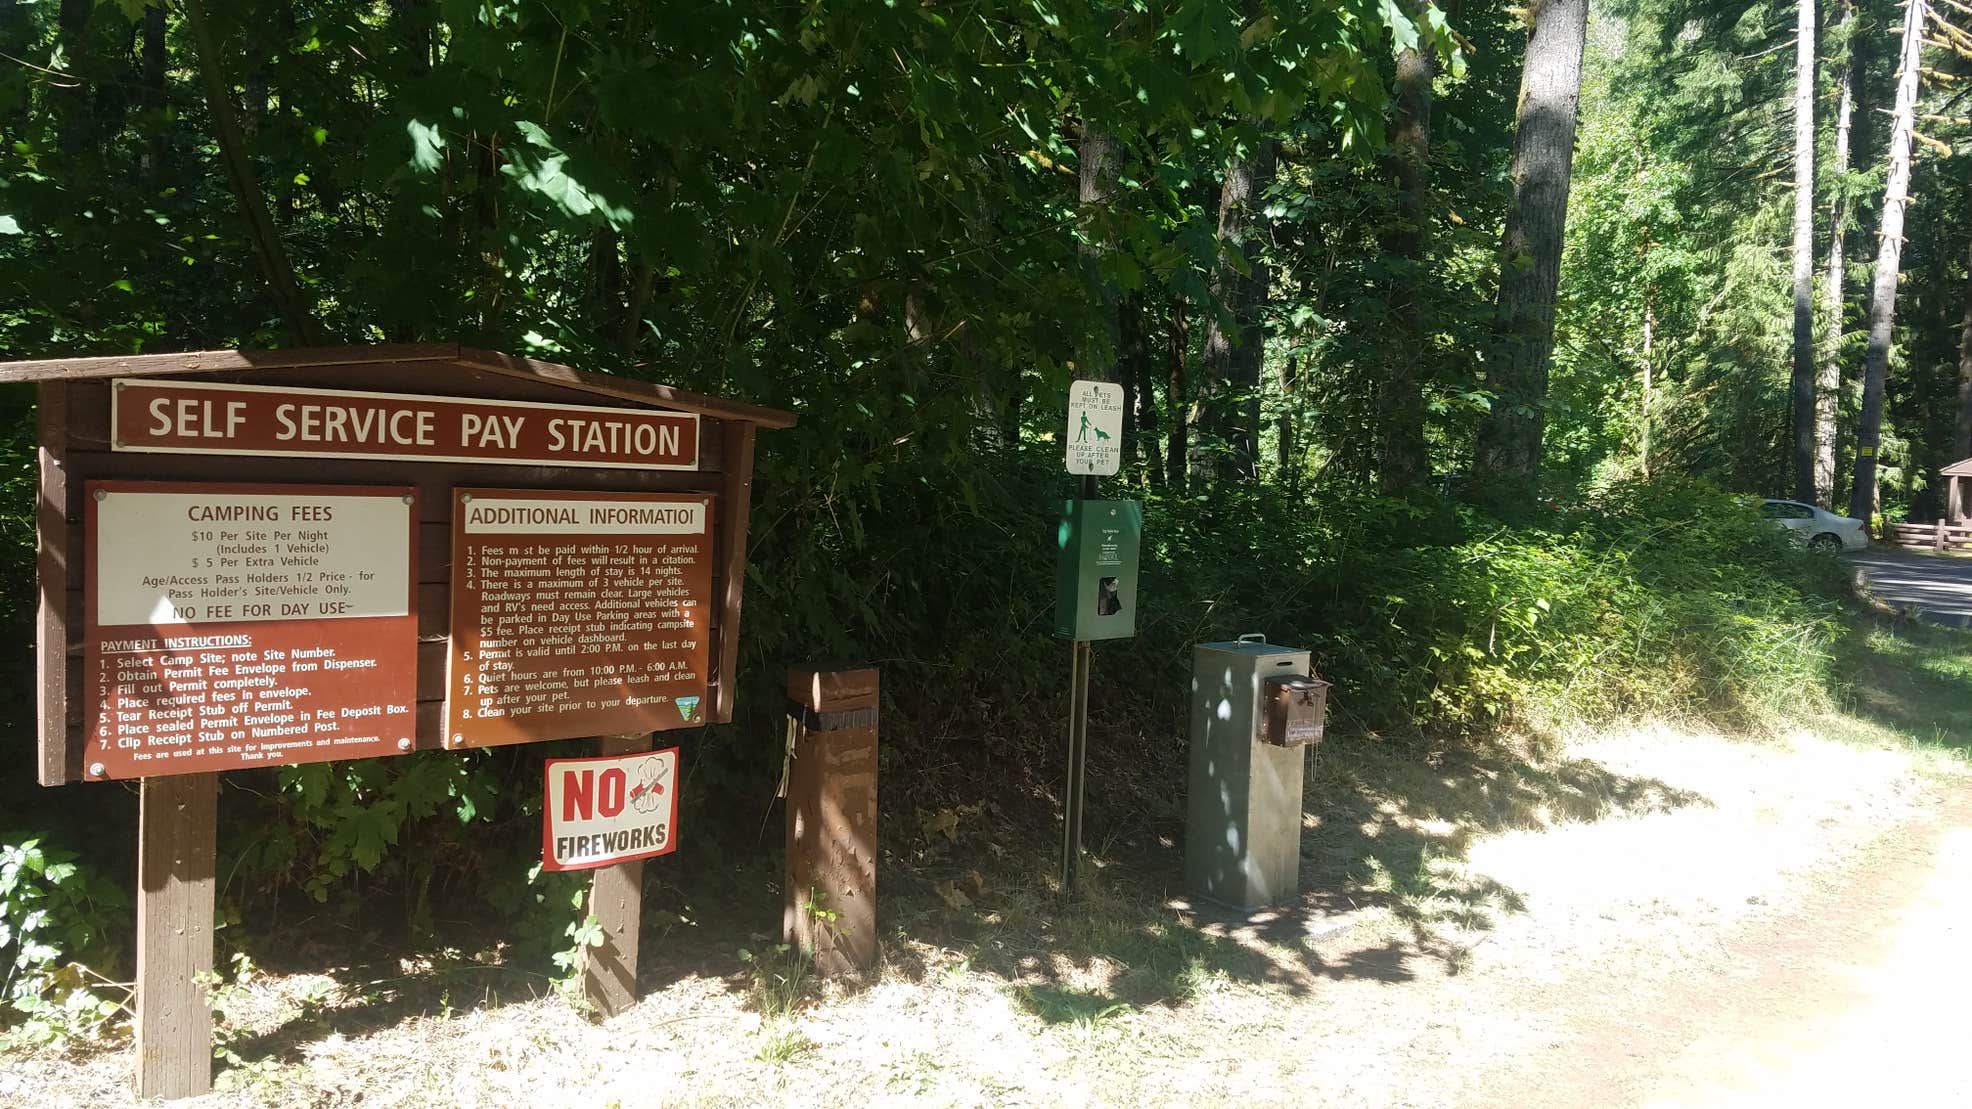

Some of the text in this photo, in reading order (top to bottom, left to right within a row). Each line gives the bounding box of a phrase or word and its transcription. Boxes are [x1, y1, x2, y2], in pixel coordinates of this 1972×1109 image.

[149, 398, 680, 457] SELF SERVICE PAY STATION
[188, 506, 332, 521] CAMPING FEES
[470, 508, 579, 524] ADDITIONAL
[192, 531, 328, 542] $10 Per Site Per Night
[216, 543, 267, 556] (Includes
[287, 543, 329, 554] Vehicle)
[467, 546, 476, 555] 1.
[482, 546, 503, 555] Fees
[539, 545, 550, 554] be
[555, 545, 576, 556] paid
[581, 545, 609, 554] within
[615, 545, 628, 553] 1/2
[633, 545, 652, 553] hour
[658, 545, 667, 553] of
[671, 545, 699, 553] arrival.
[220, 557, 238, 567] Per
[246, 557, 274, 566] Extra
[280, 556, 319, 566] Vehicle
[467, 557, 476, 566] 2.
[482, 557, 547, 567] Non-payment
[552, 555, 562, 565] of
[568, 555, 586, 564] fees
[591, 556, 607, 564] will
[610, 556, 635, 564] result
[640, 556, 647, 564] in
[662, 556, 696, 564] citation.
[142, 571, 375, 588] Age/Access Pass Holders 1/2 Price for
[467, 566, 683, 578] 3. The maximum length of stay is 14 nights.
[169, 584, 351, 598] Pass Holder's Site/Vehicle Only.
[173, 607, 196, 619] NO
[207, 606, 232, 618] FEE
[243, 604, 271, 616] FOR
[281, 603, 309, 615] DAY
[101, 635, 251, 651] PAYMENT INSTRUCTIONS:
[100, 647, 336, 669] 1. Select Camp Site; note Site Number.
[100, 659, 377, 682] 2. Obtain Permit Fee Envelope from Dispenser.
[464, 674, 473, 683] 6.
[479, 673, 506, 683] Quiet
[511, 671, 537, 680] hours
[563, 668, 584, 677] from
[591, 666, 614, 675] 10:00
[620, 664, 637, 673] P.M.
[647, 662, 665, 671] 6:00
[669, 661, 688, 670] A.M.
[100, 676, 278, 696] 3. Fill out Permit completely.
[100, 687, 311, 709] 4. Place required fees in envelope.
[100, 700, 293, 723] 5. Tear Receipt Stub off Permit.
[100, 705, 408, 736] 6. Place sealed Permit Envelope in Fee Deposit Box.
[101, 722, 340, 750] 7. Clip Receipt Stub on Numbered Post.
[174, 749, 192, 757] used
[261, 741, 313, 751] improvements
[334, 736, 380, 744] maintenance.
[563, 768, 626, 822] NO
[557, 824, 666, 859] FIREWORKS
